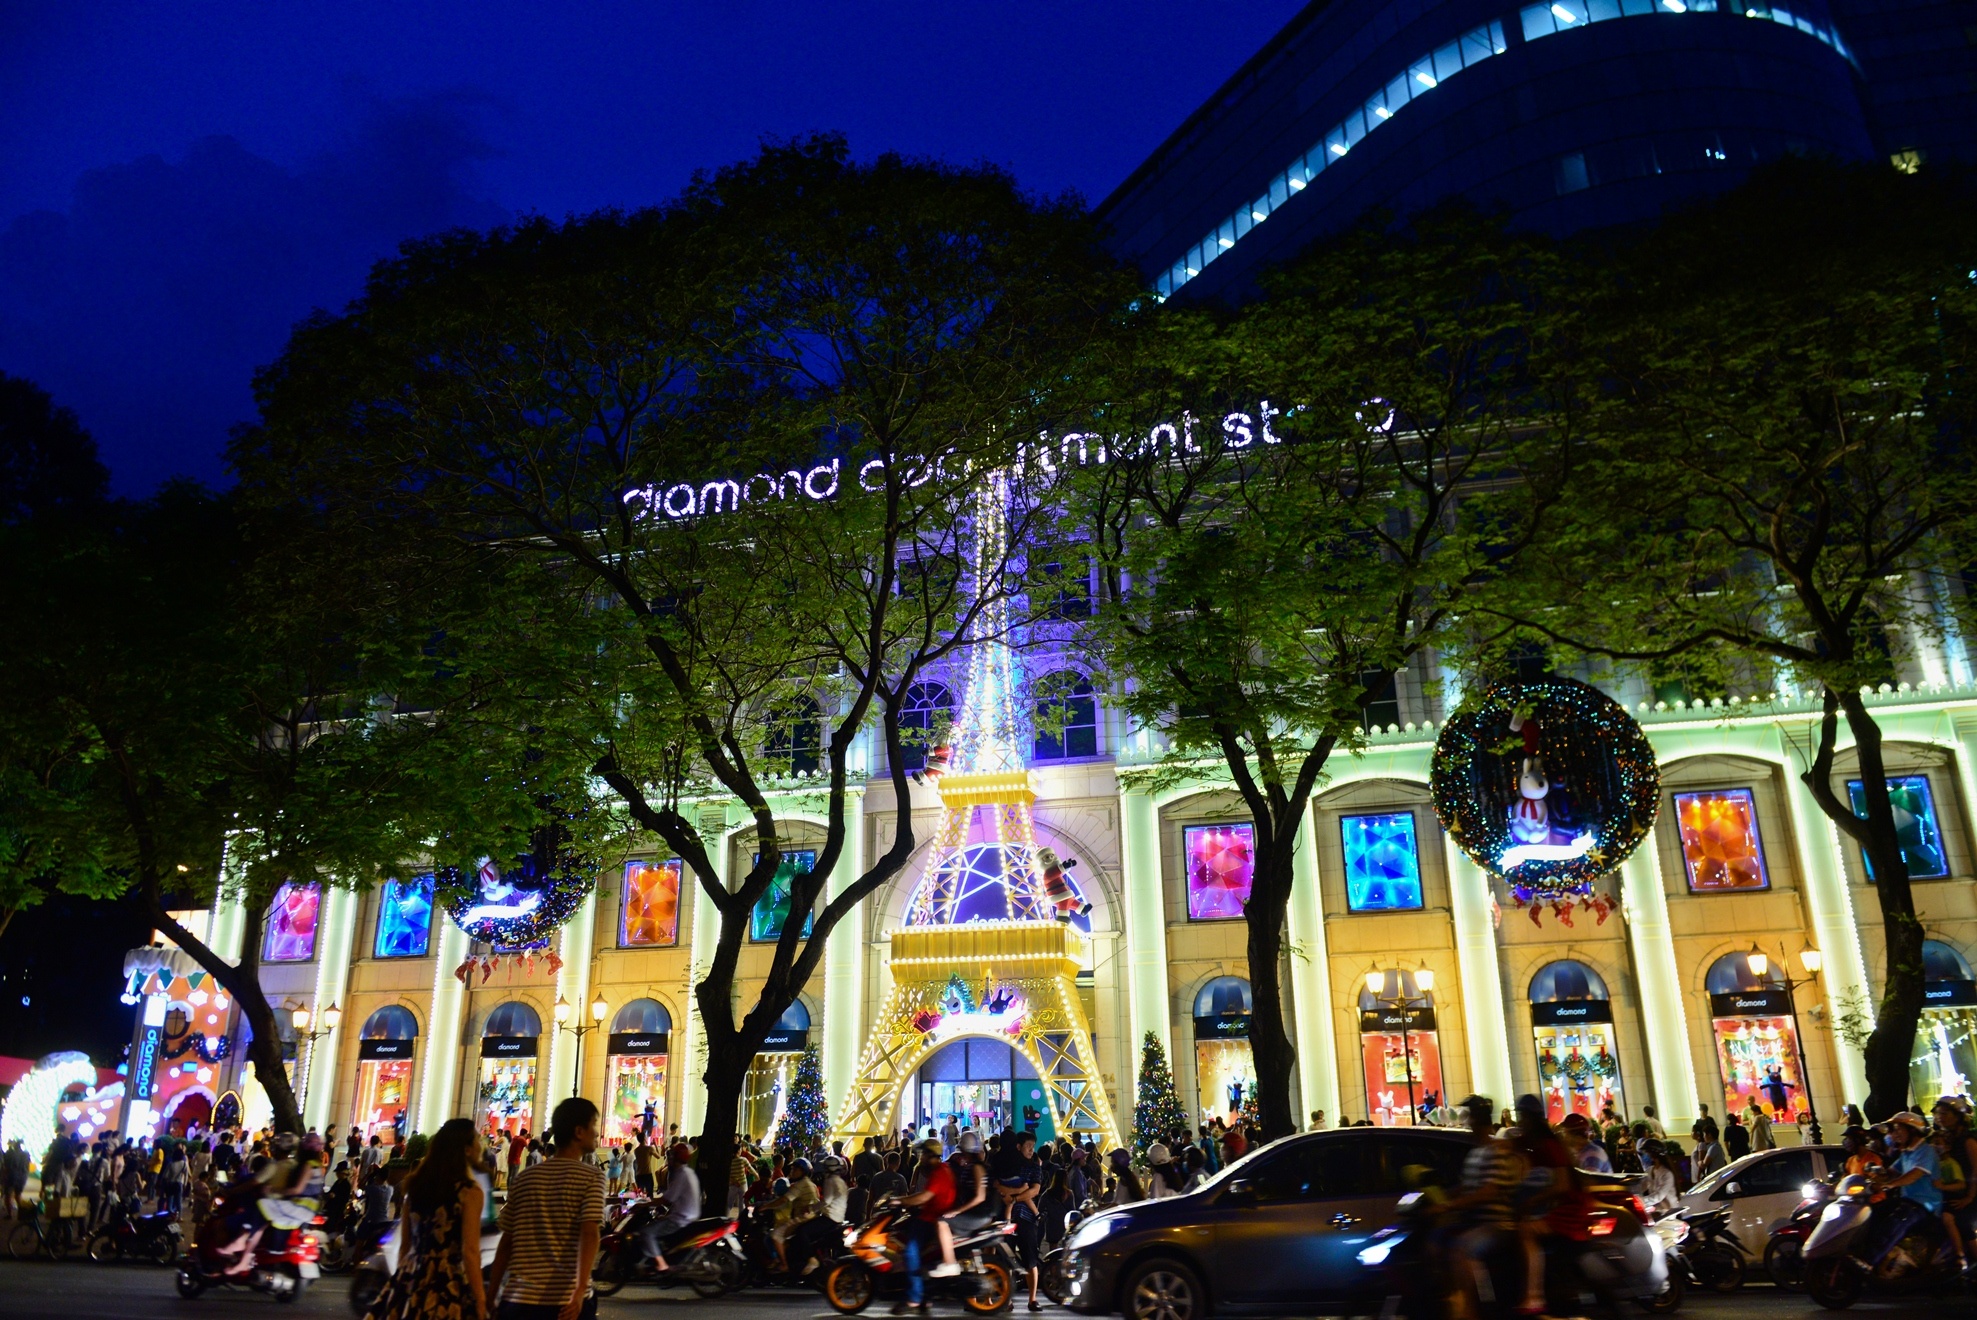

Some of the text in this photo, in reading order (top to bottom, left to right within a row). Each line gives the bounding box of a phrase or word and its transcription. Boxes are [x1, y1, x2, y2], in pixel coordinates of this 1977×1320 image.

[1735, 999, 1767, 1008] diamond
[1556, 1007, 1587, 1016] diamond
[627, 1040, 651, 1048] diamond
[764, 1036, 788, 1044] diamond
[376, 1045, 398, 1053] diamond
[498, 1043, 521, 1051] diamond
[138, 1029, 159, 1097] diamond
